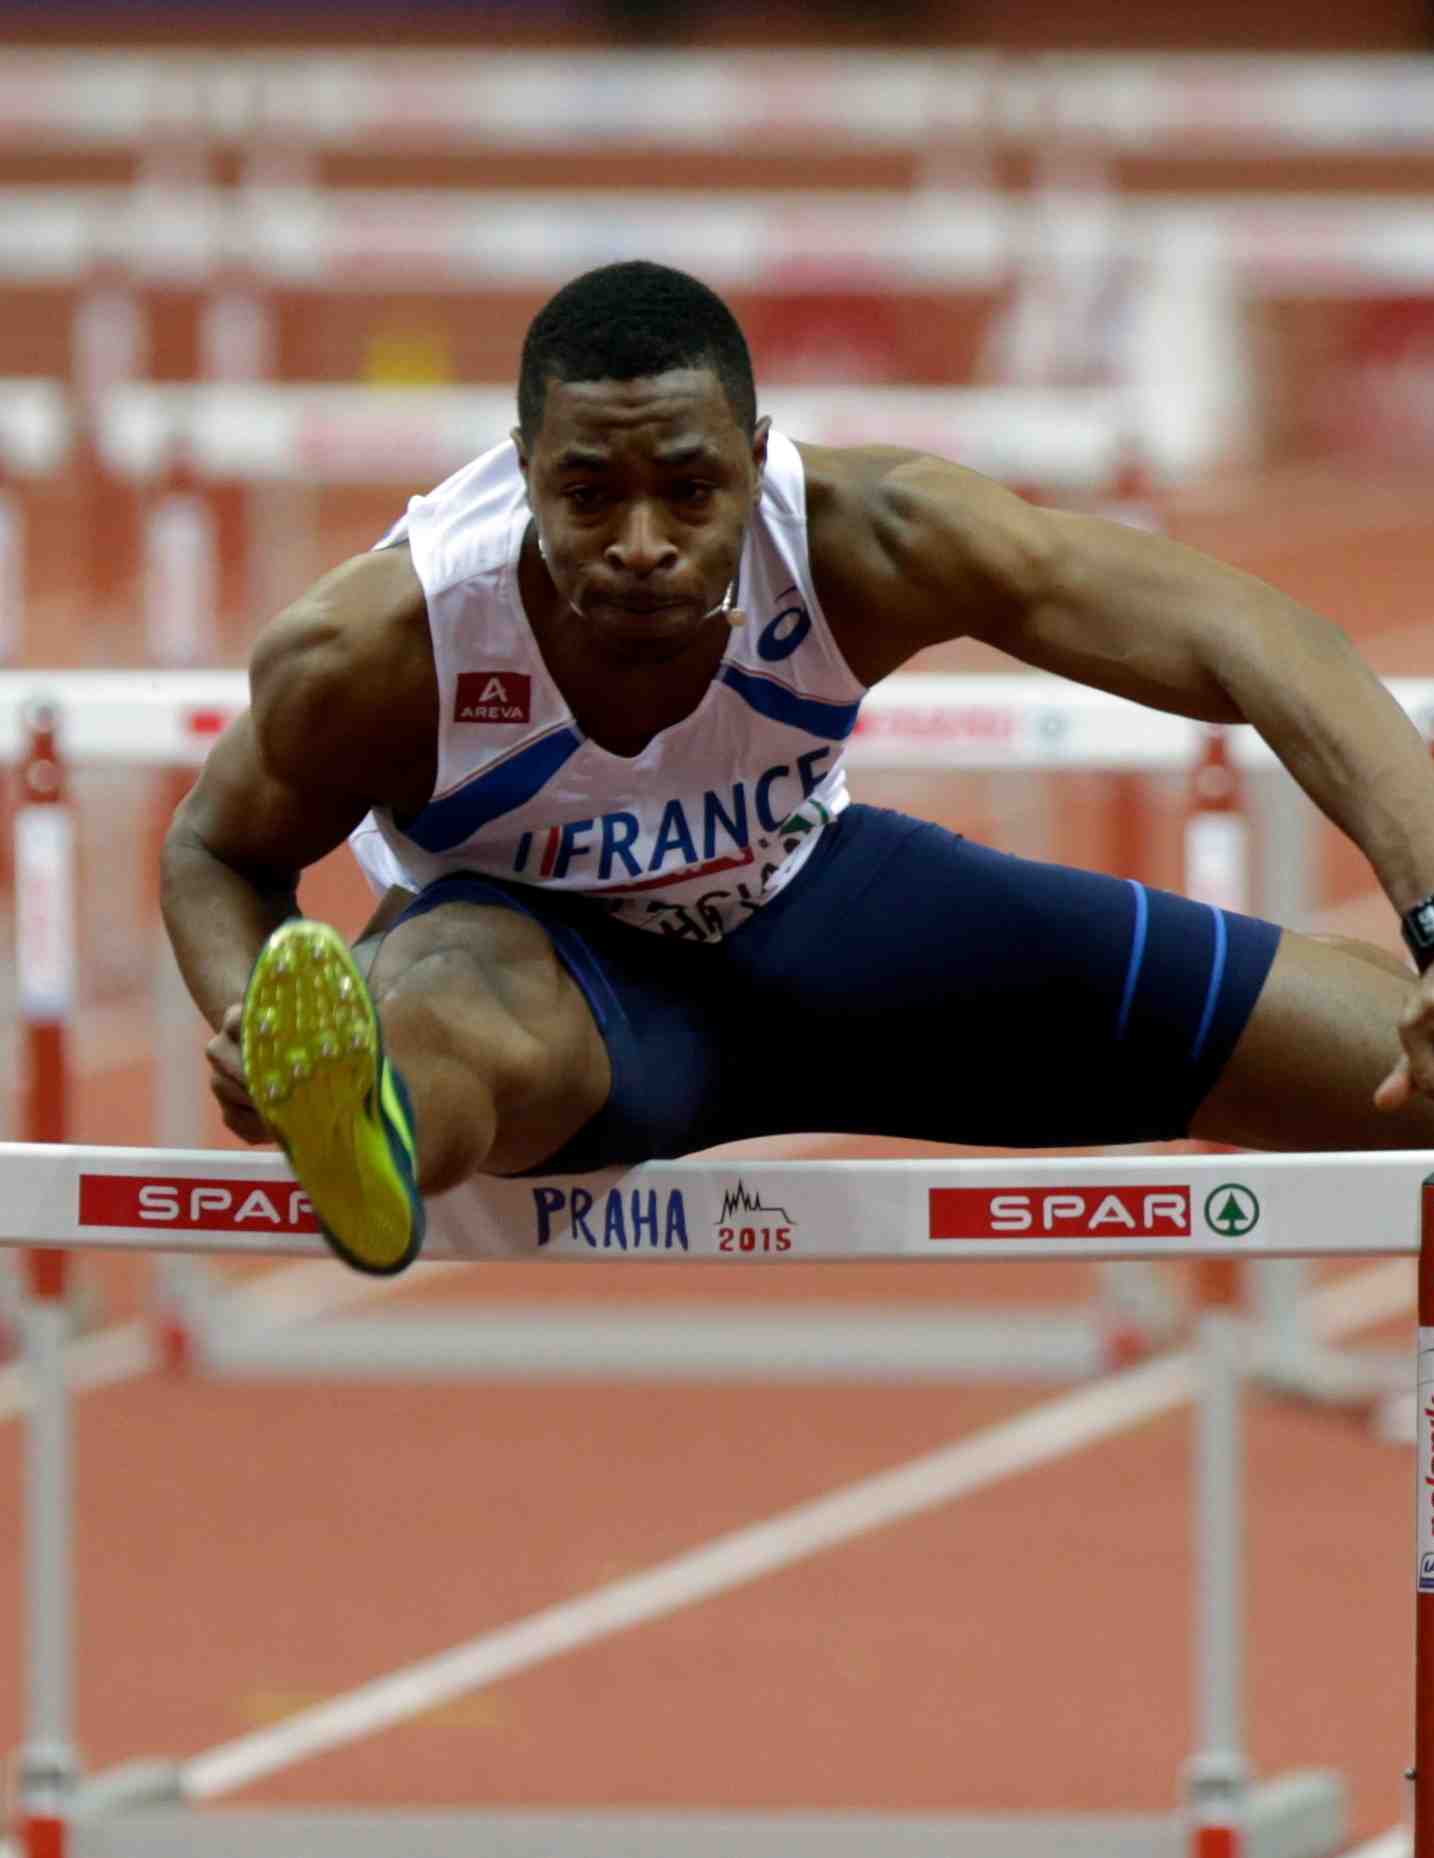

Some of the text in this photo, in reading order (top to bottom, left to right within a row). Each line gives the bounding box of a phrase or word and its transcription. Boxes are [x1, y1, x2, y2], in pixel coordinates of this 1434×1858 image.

[460, 706, 525, 721] AREVA
[553, 747, 834, 881] FRANCE
[533, 1187, 690, 1251] PRAHA
[989, 1194, 1187, 1232] SPAR
[718, 1227, 793, 1253] 2015
